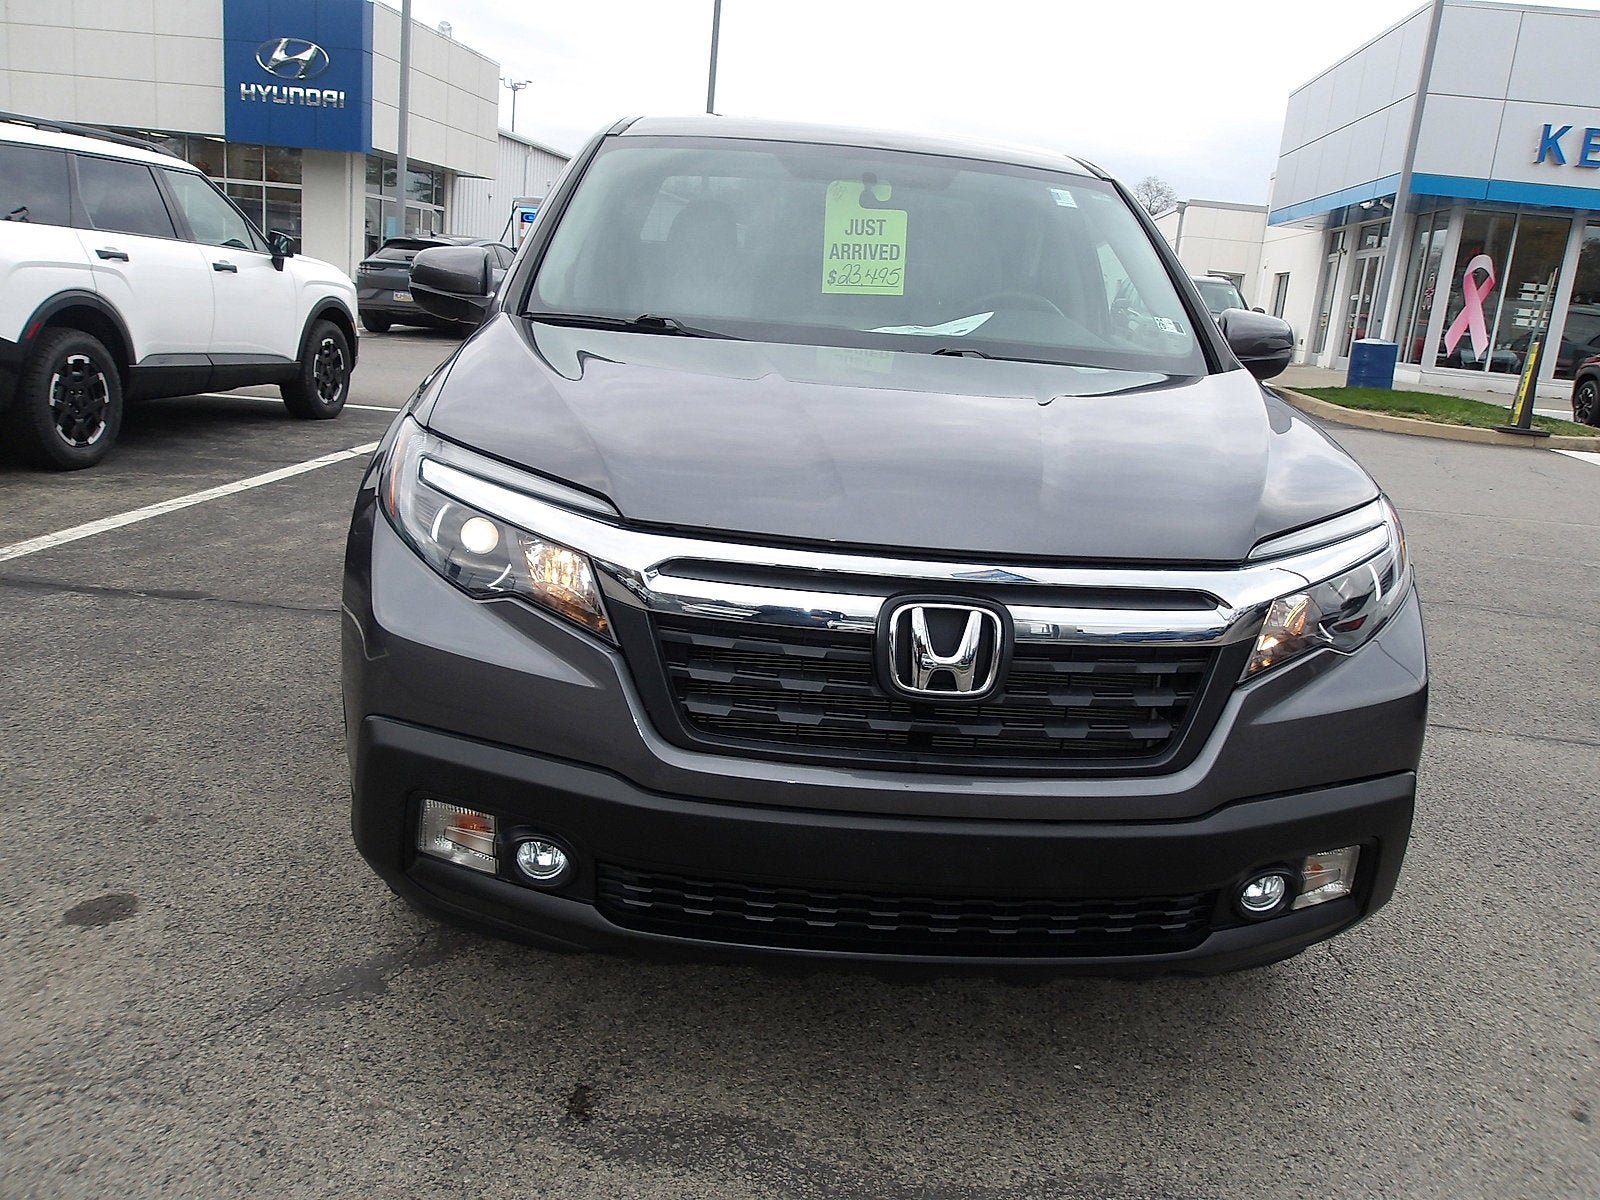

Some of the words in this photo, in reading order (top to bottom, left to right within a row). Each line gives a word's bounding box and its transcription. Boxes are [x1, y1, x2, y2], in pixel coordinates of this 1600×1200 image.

[240, 82, 345, 108] HYUNDAI
[845, 219, 887, 236] JUST
[829, 243, 901, 260] ARRIVED
